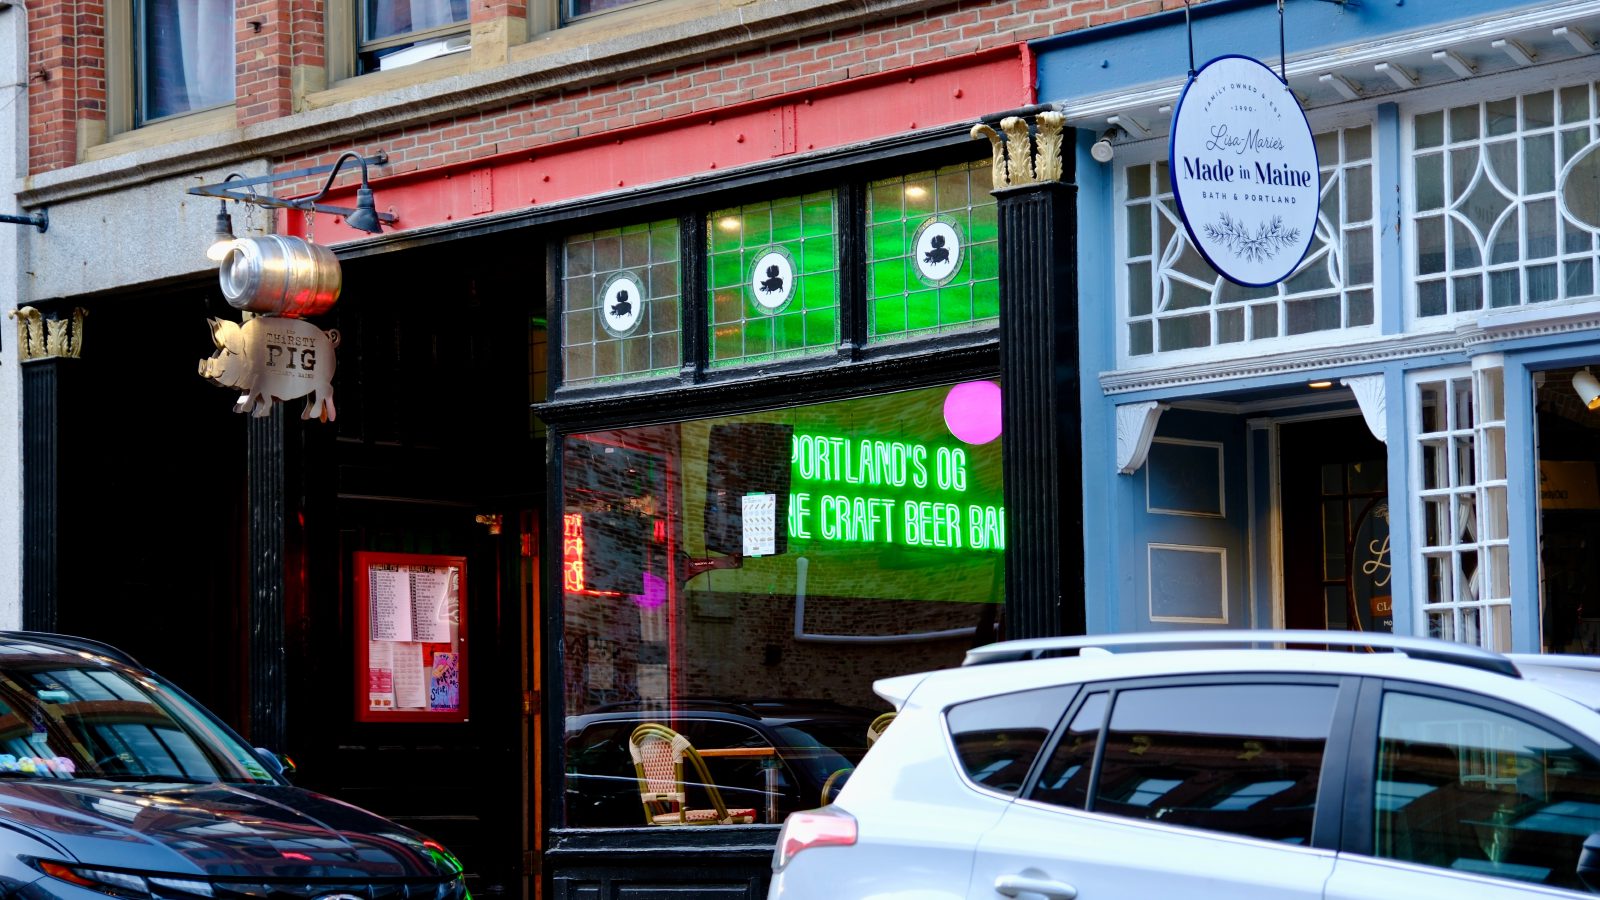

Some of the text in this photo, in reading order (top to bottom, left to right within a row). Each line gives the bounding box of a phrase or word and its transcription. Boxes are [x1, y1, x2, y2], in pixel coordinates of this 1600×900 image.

[1204, 86, 1226, 112] FAMILY
[1230, 83, 1257, 93] OWNED
[1183, 156, 1311, 187] Made in Maine
[1202, 191, 1227, 200] BATH
[1244, 194, 1296, 204] PORTLAND
[266, 345, 316, 371] PIG
[936, 447, 967, 492] OG
[821, 495, 895, 543] CRAFT
[904, 500, 962, 548] BEER
